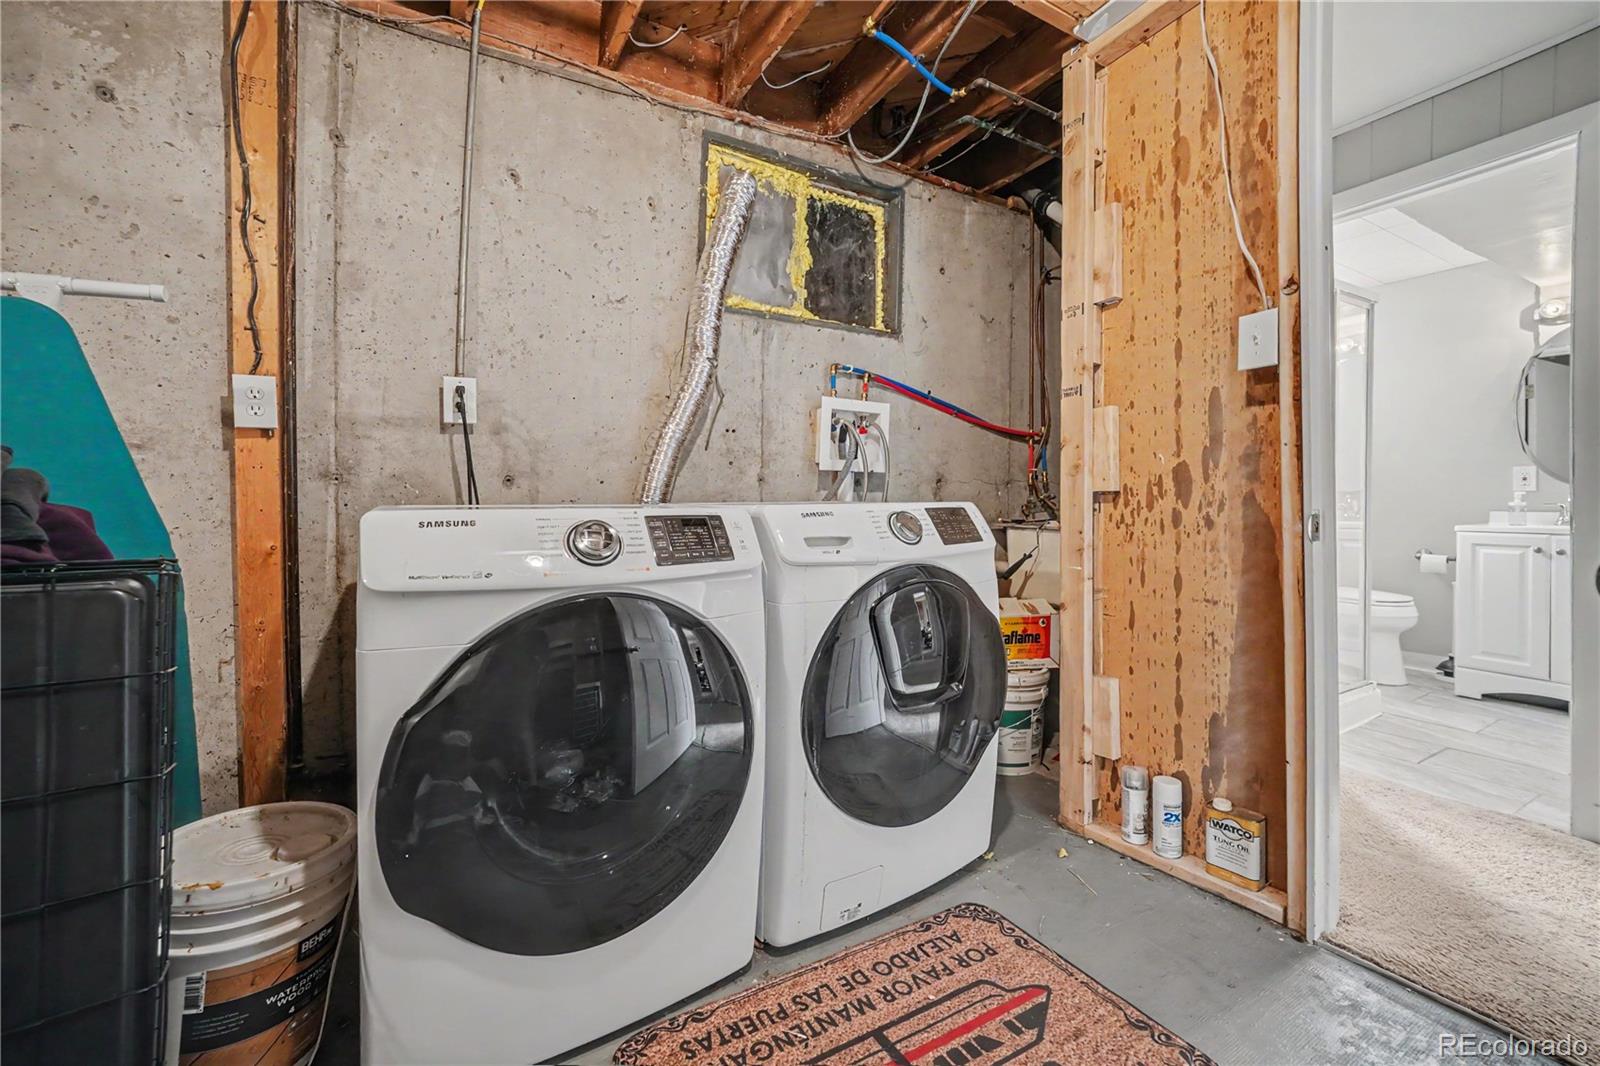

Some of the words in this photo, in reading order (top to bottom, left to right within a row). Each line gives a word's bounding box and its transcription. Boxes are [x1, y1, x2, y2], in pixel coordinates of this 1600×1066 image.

[418, 520, 476, 529] SAMSUNG
[801, 511, 834, 519] SAMSUNG
[1001, 630, 1041, 645] aflame
[1164, 812, 1181, 823] 2X
[1212, 820, 1251, 840] WATCO
[1213, 835, 1235, 847] TUNG
[872, 930, 962, 976] ALEJADO
[952, 942, 999, 969] POR
[836, 969, 872, 992] DE
[877, 960, 955, 1003] FAVOR
[277, 981, 312, 1008] WOOD
[792, 982, 838, 1011] LAS
[680, 1002, 789, 1060] PUERTAS
[707, 994, 876, 1066] MANTÉNGA
